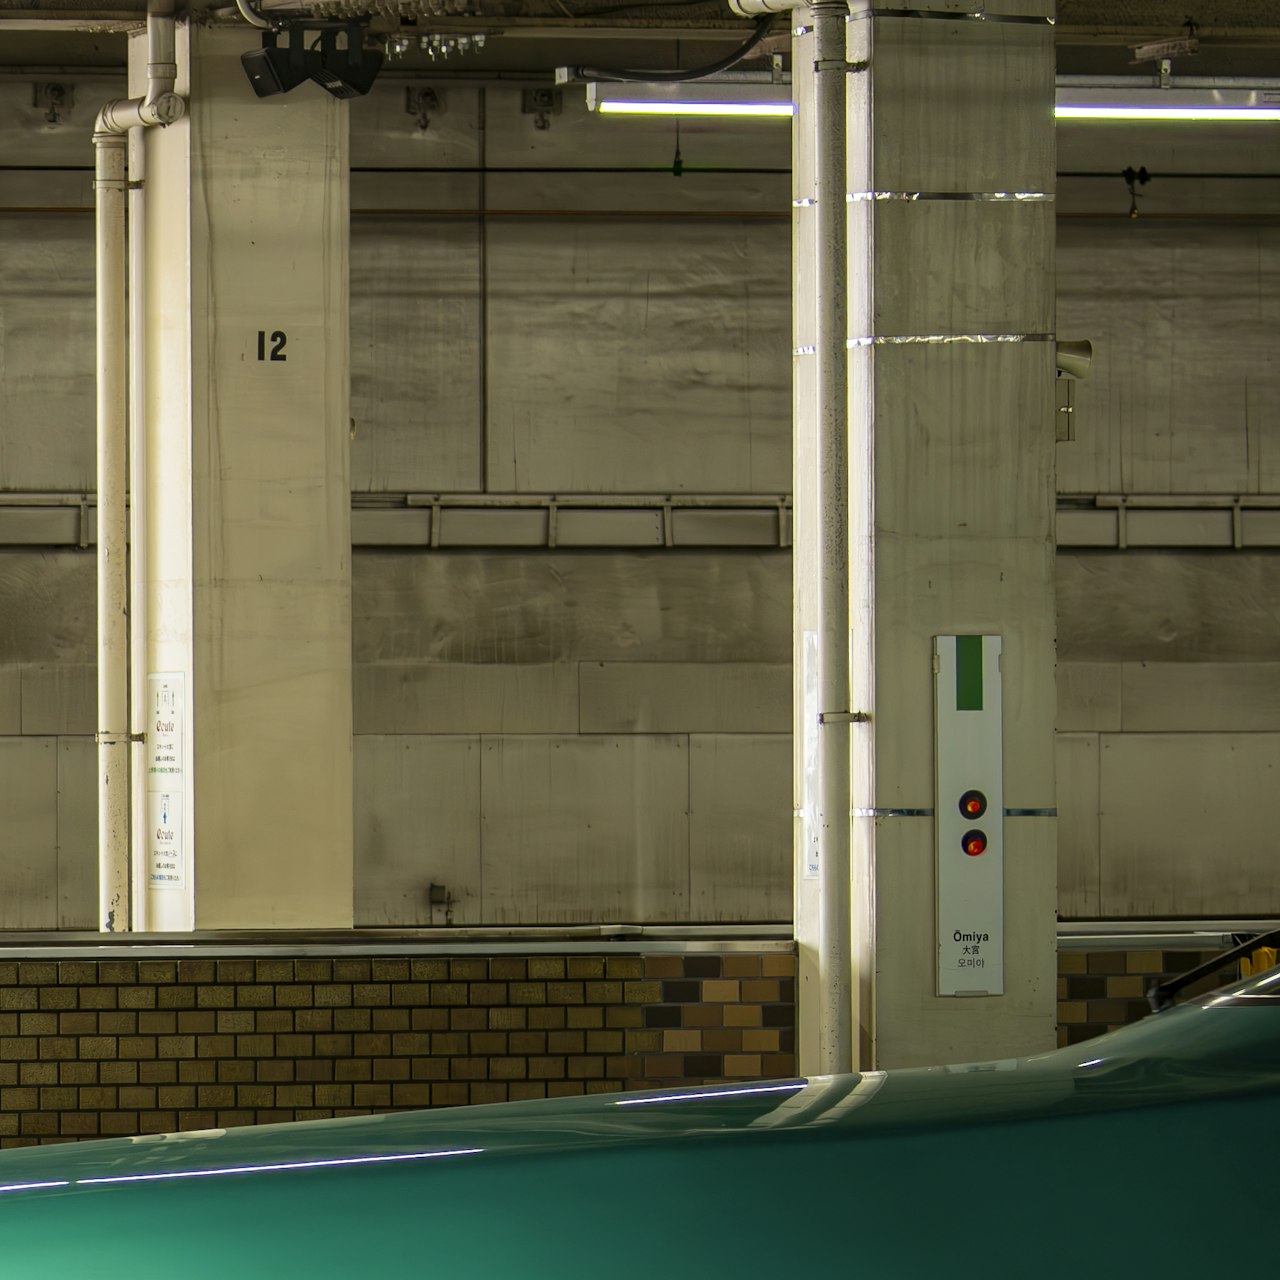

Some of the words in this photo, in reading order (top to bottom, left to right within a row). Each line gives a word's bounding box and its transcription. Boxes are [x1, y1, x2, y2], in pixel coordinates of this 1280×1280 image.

[257, 330, 287, 361] 12
[953, 929, 989, 944] Ōmiya
[962, 945, 980, 955] 大宮
[957, 958, 985, 969] 오미야
